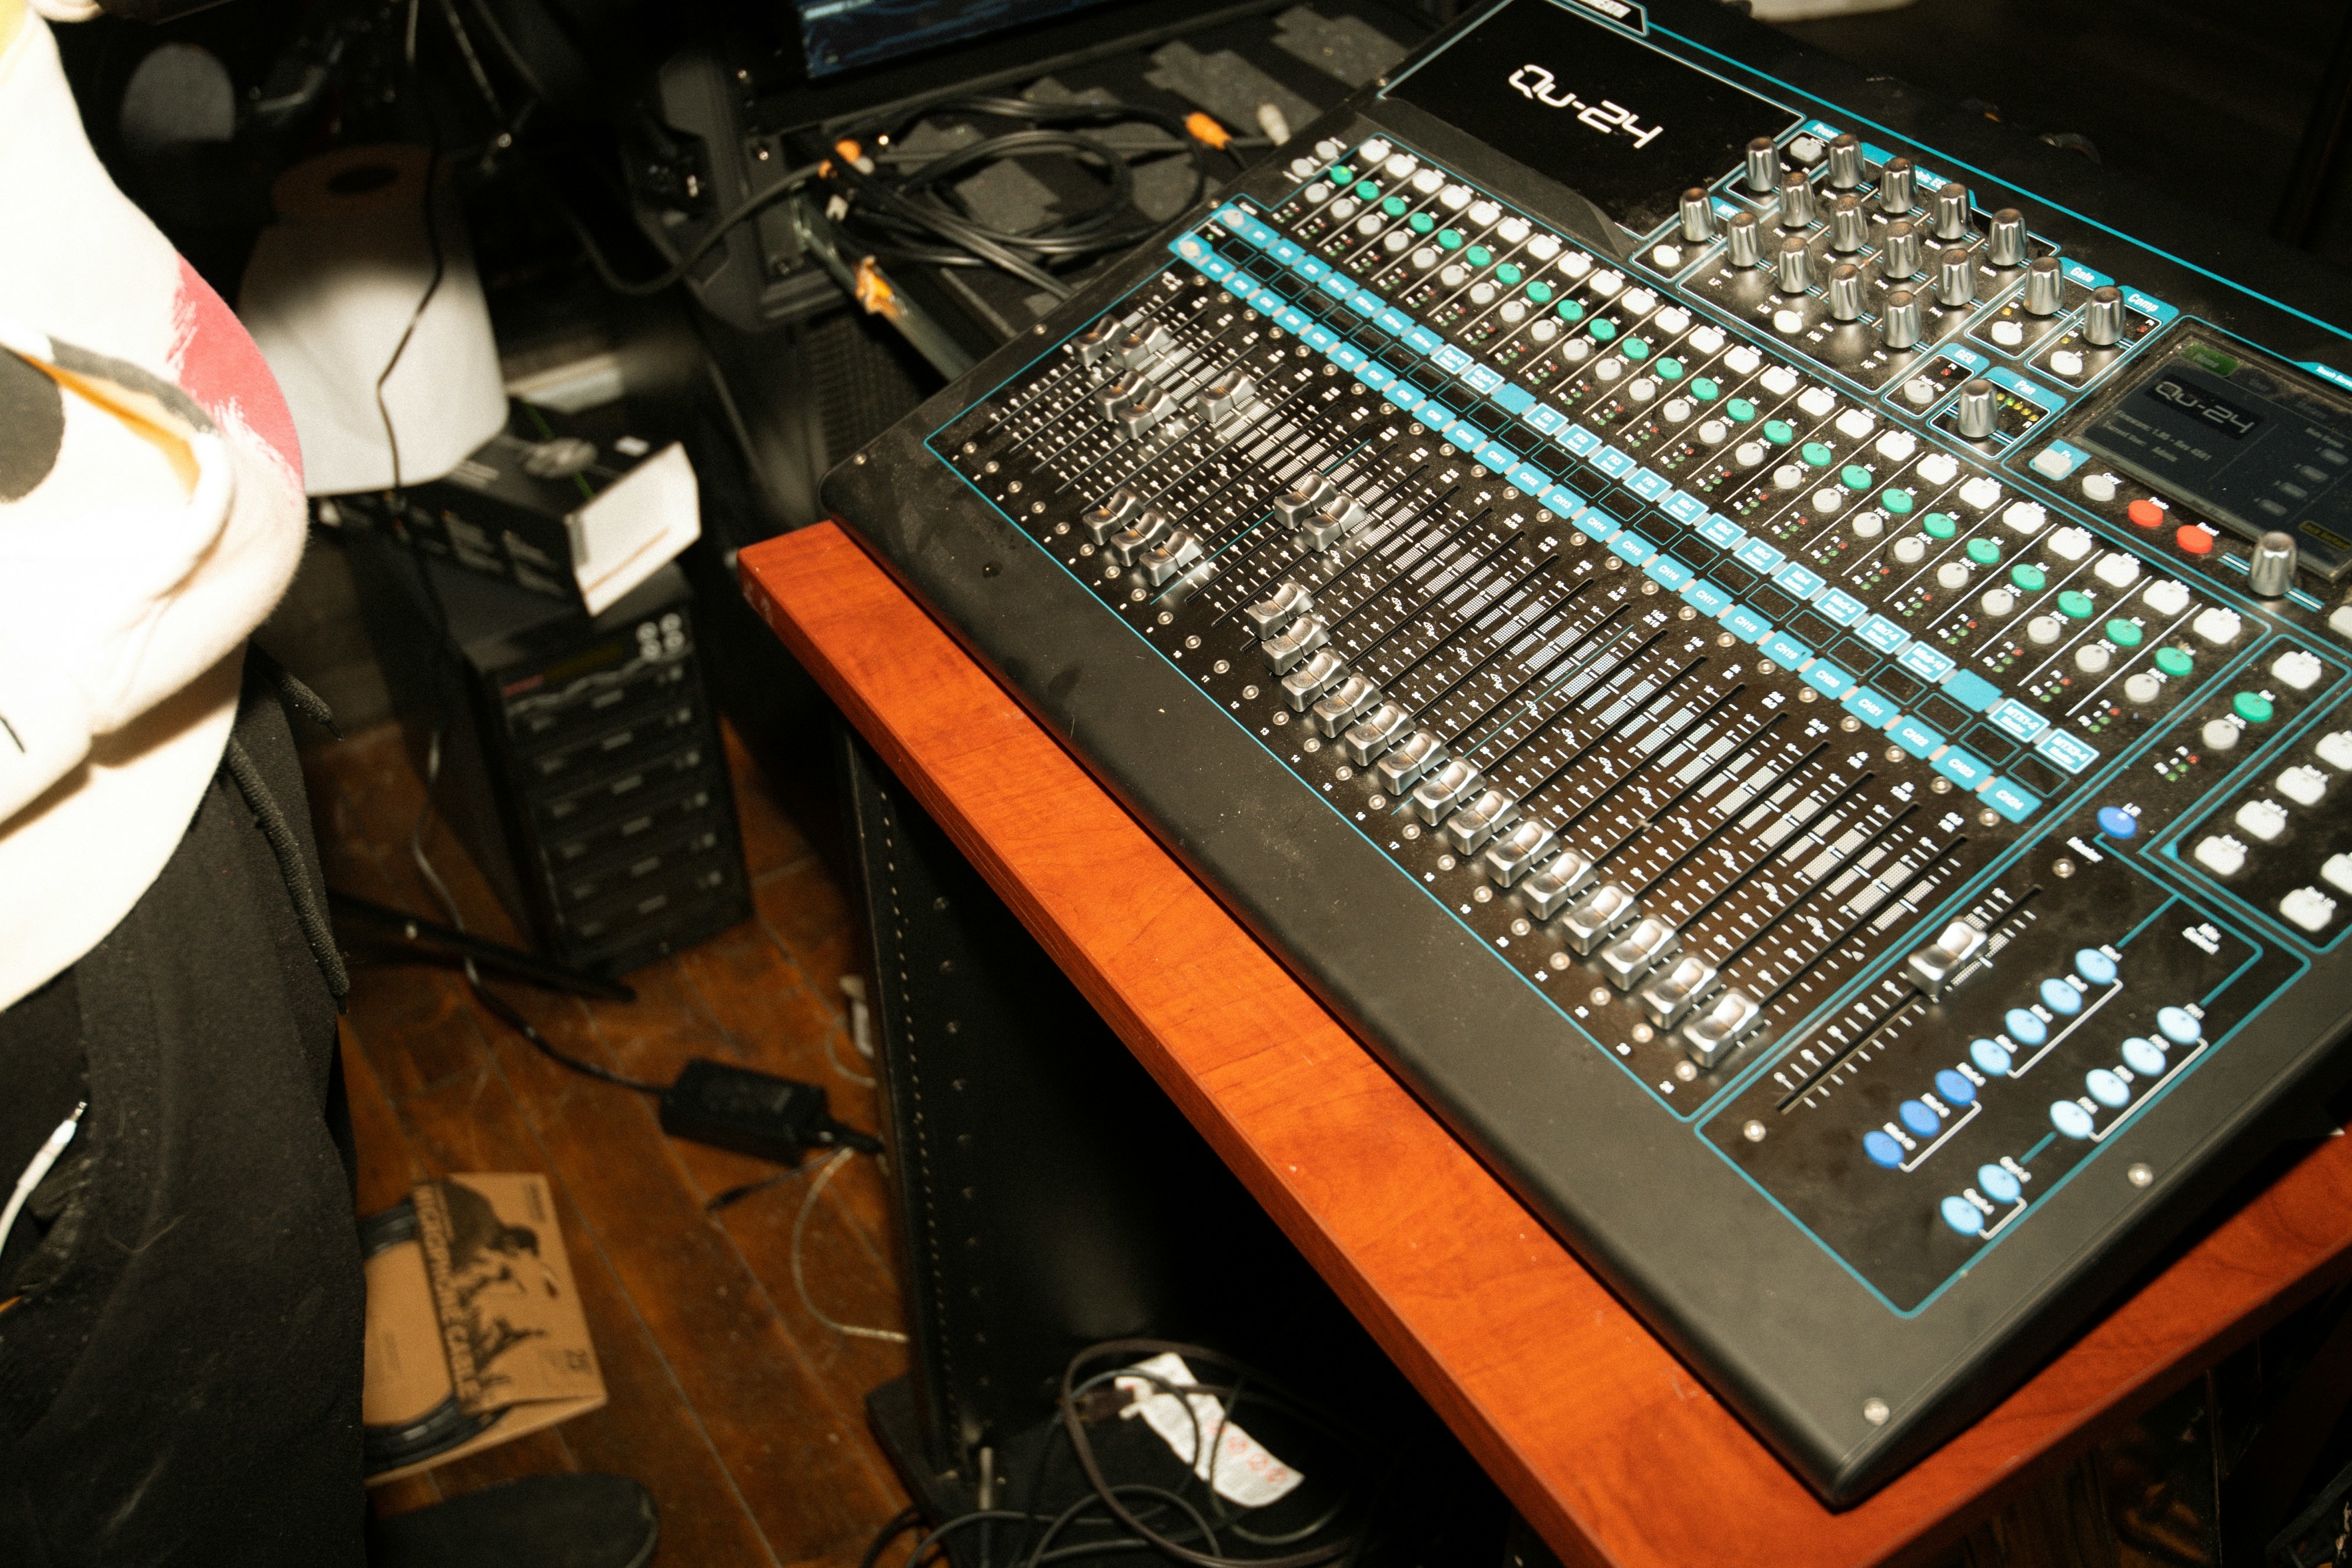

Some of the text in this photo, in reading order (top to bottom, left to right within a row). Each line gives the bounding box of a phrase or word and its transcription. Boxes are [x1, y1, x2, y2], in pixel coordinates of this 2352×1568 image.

[1509, 64, 1663, 149] Qu-24
[2070, 267, 2094, 282] Gate
[2128, 294, 2158, 312] Comp
[1955, 349, 1976, 364] GEQ
[2014, 380, 2036, 395] Pan
[2156, 382, 2254, 433] Qu-24
[1520, 473, 1538, 486] CH12
[1553, 494, 1572, 509] CH13
[1587, 517, 1606, 531] CH14
[1623, 541, 1642, 556] CH15
[1659, 566, 1679, 580] CH16
[1696, 590, 1718, 605] CH17
[1735, 617, 1757, 632] CH18
[1775, 643, 1798, 659] CH19
[1859, 699, 1883, 716] CH21
